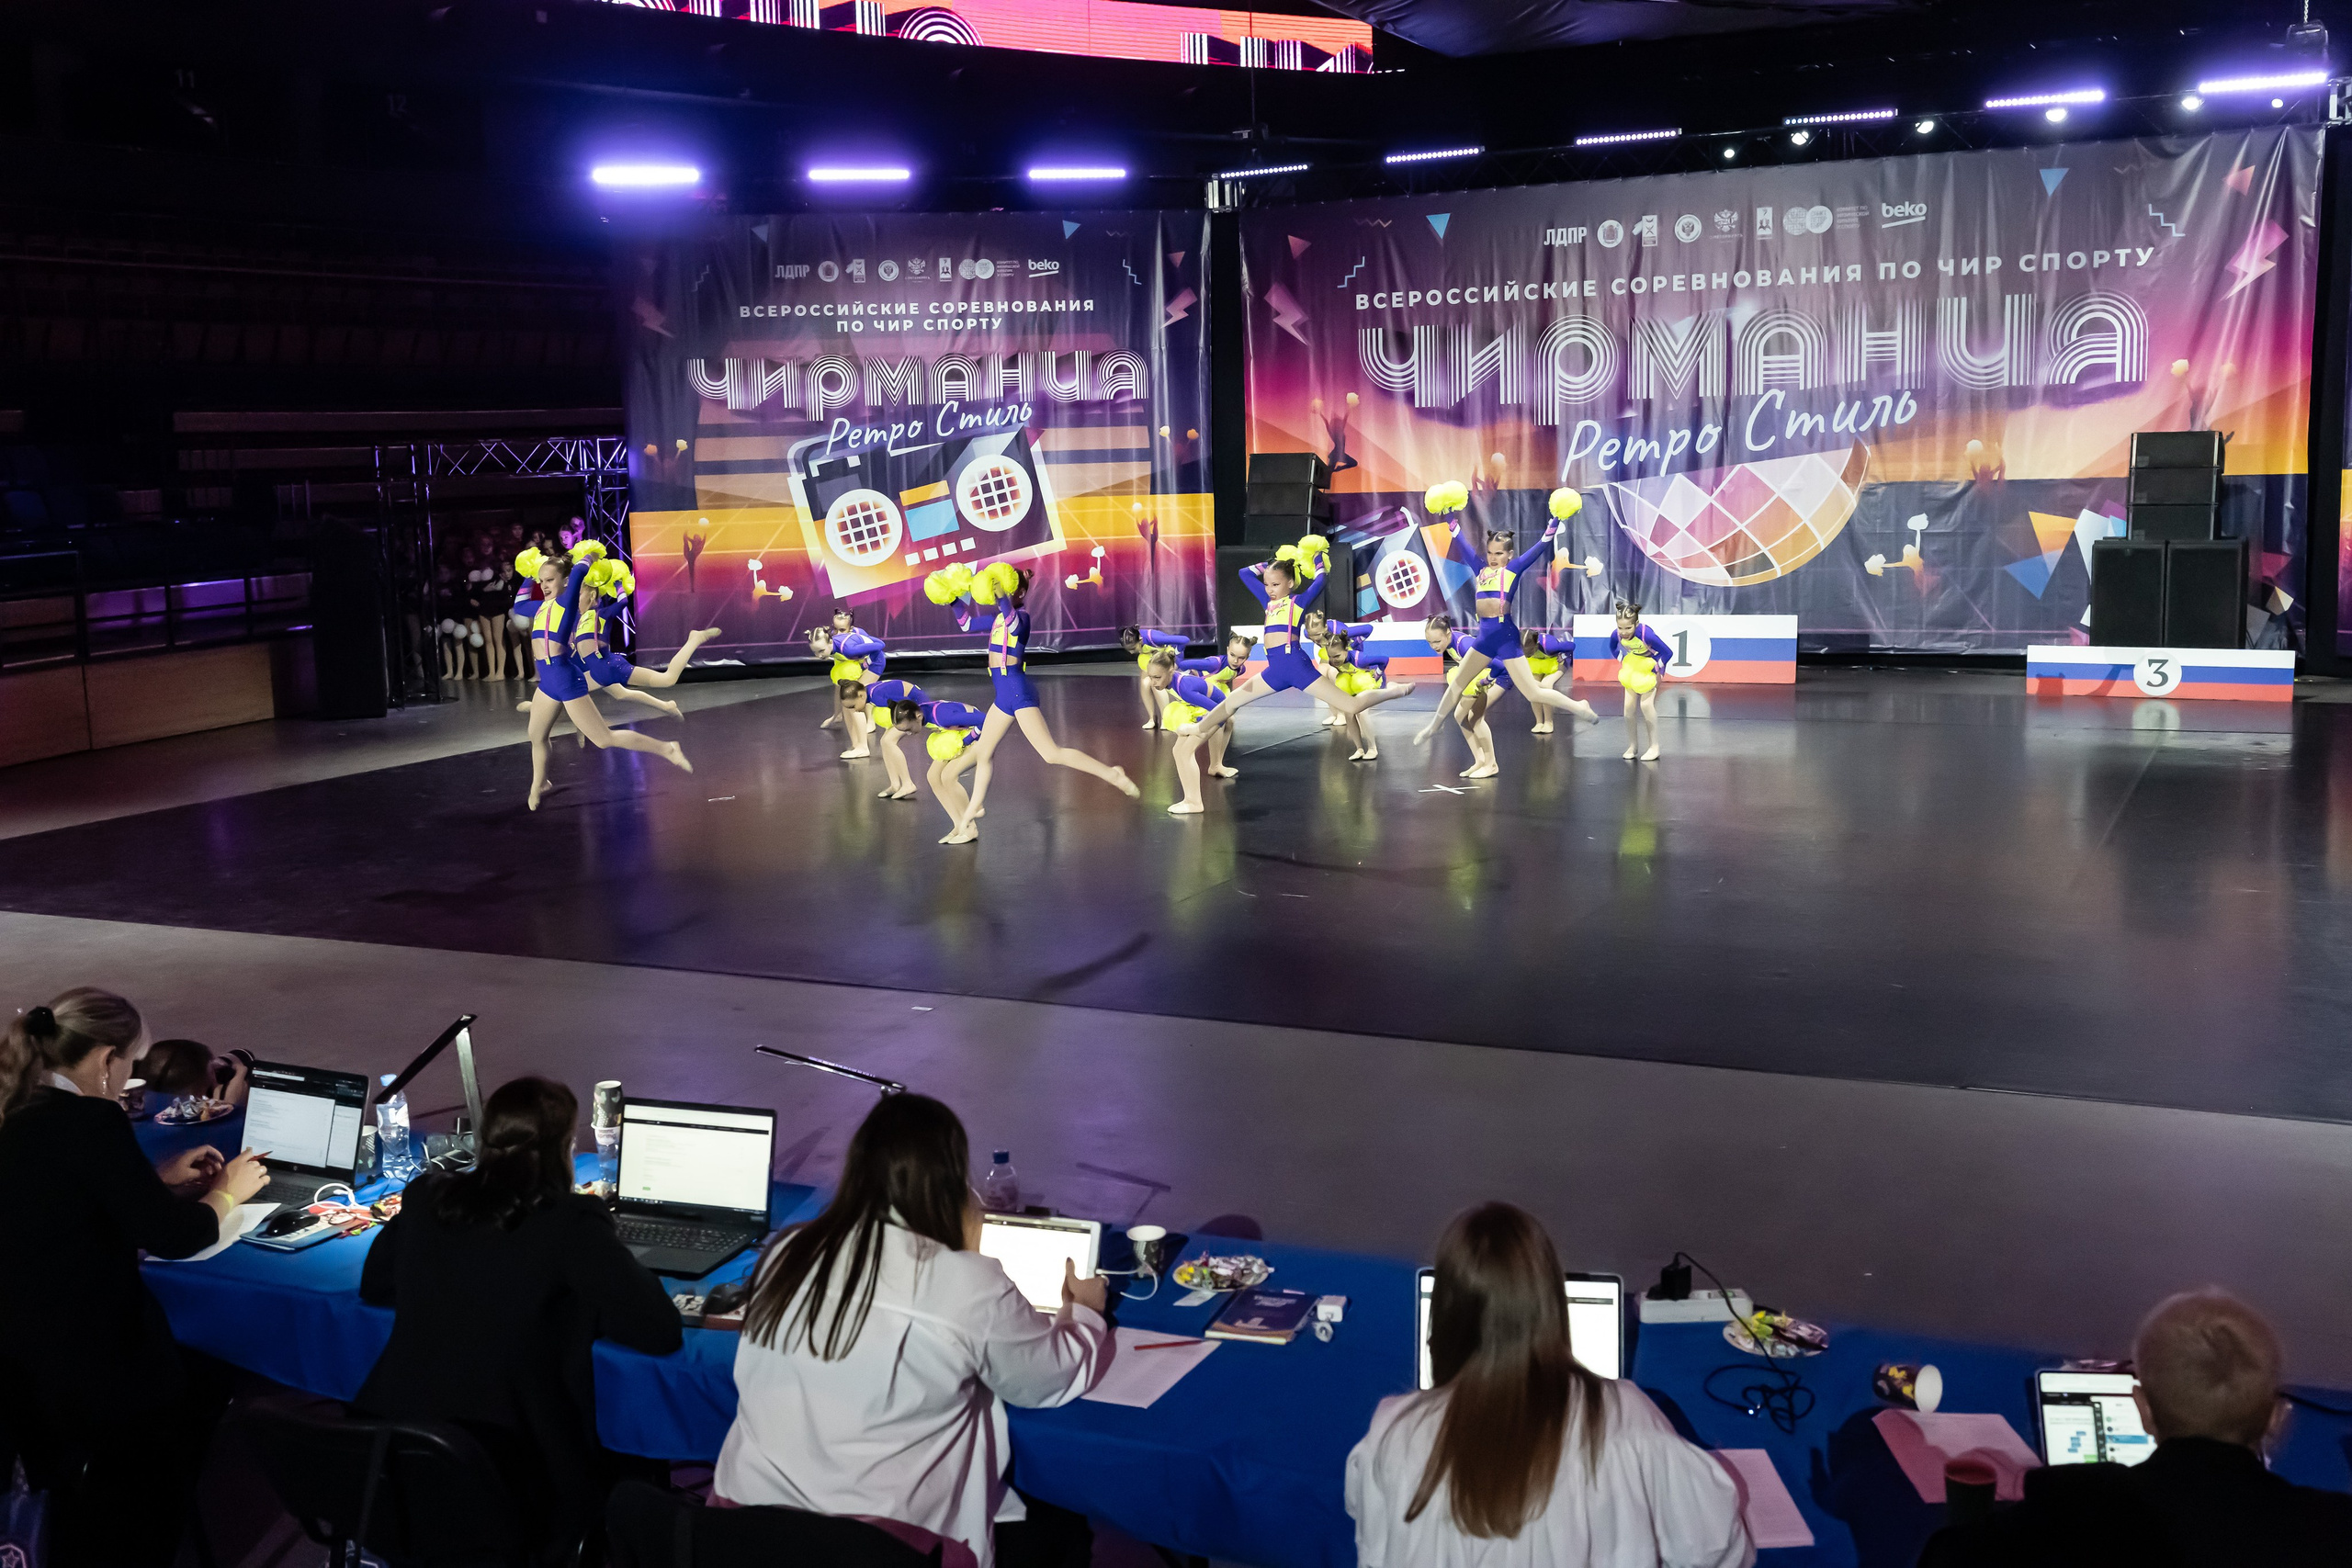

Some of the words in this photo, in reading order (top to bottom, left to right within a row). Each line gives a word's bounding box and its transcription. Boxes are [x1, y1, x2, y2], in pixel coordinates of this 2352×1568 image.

[1882, 201, 1928, 218] beko
[1544, 226, 1588, 247] ЛДПР
[775, 264, 810, 280] ЛДПР
[1027, 259, 1060, 272] beko
[1355, 282, 1597, 310] ВСЕРОССИЙСКИЕ
[1611, 263, 1862, 294] СОРЕВНОВАНИЯ
[1879, 260, 1922, 280] ПО
[1938, 255, 2003, 277] ЧИР
[2018, 246, 2155, 275] СПОРТУ
[740, 299, 921, 318] ВСЕРОССИЙСКИЕ
[928, 299, 1095, 314] СОРЕВНОВАНИЯ
[836, 320, 865, 333] ПО
[874, 319, 915, 333] ЧИР
[922, 316, 1003, 332] СПОРТУ
[825, 416, 922, 455] Ретро
[935, 399, 1034, 438] Стиль
[1561, 420, 1722, 482] Ретро
[1745, 387, 1918, 452] Стиль
[1672, 630, 1692, 667] 1
[2146, 659, 2169, 687] 3
